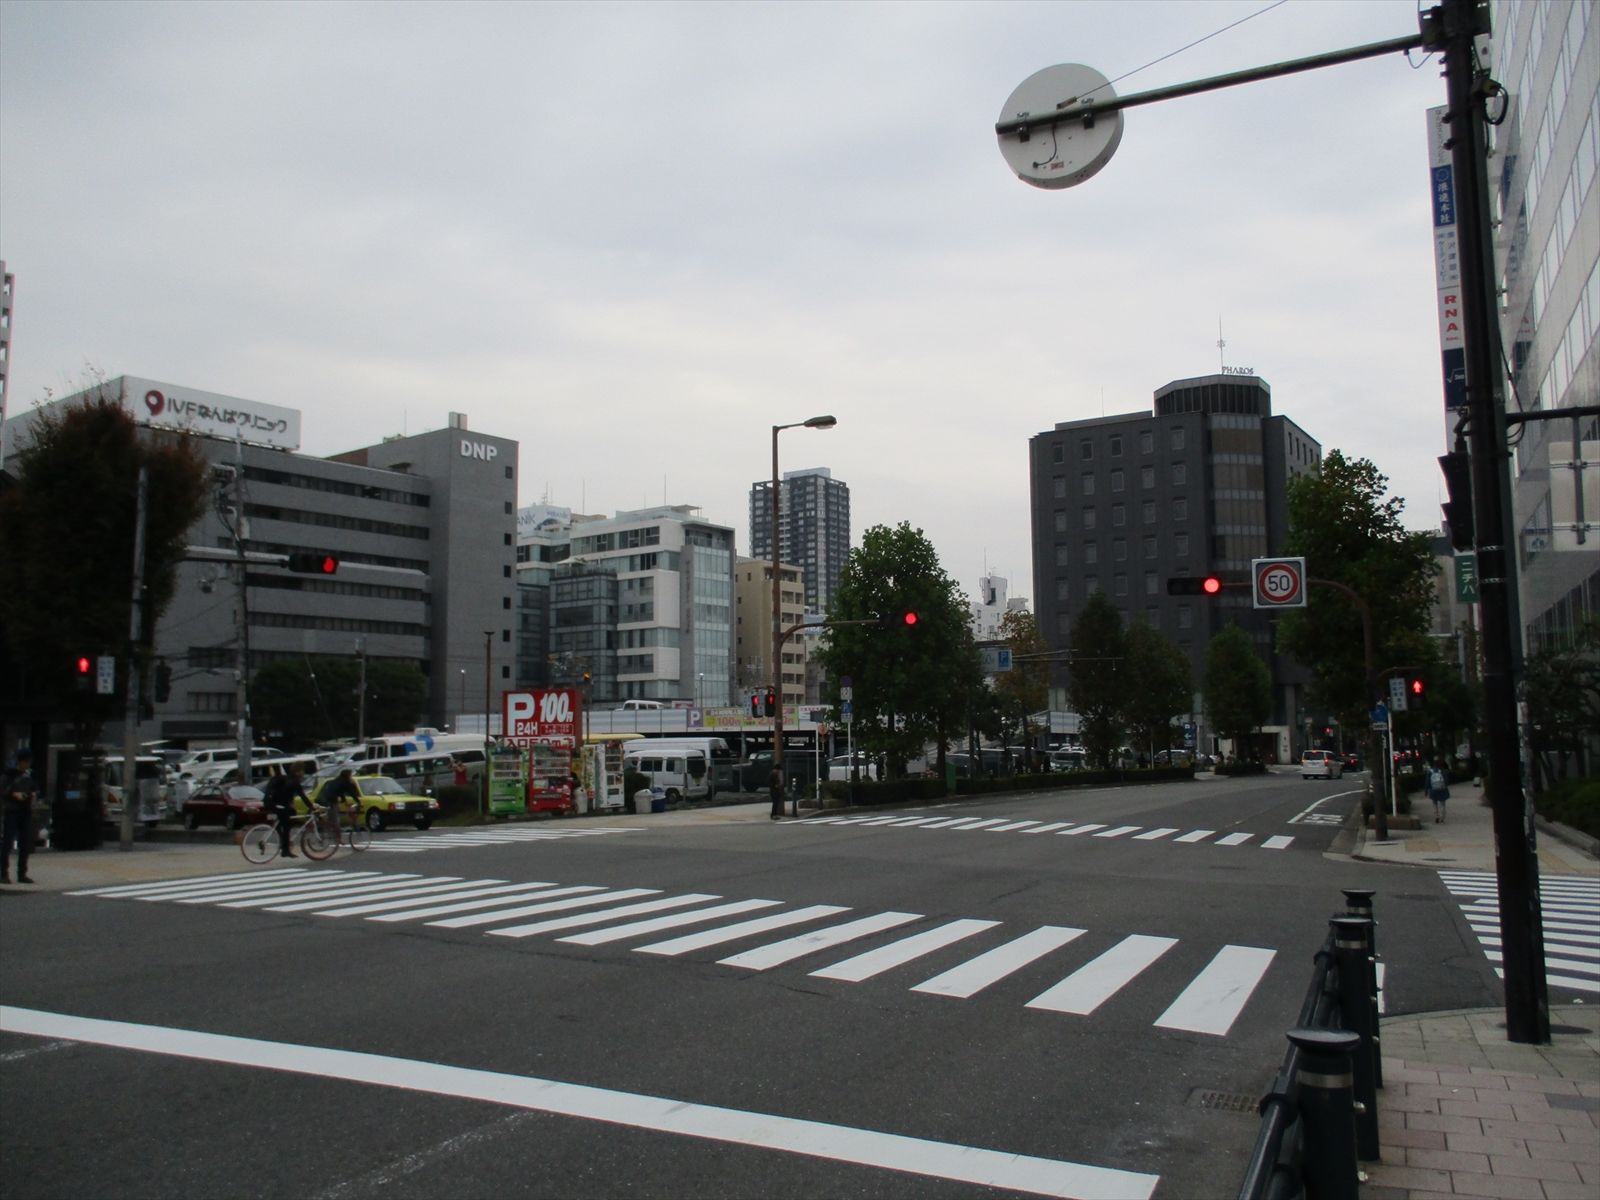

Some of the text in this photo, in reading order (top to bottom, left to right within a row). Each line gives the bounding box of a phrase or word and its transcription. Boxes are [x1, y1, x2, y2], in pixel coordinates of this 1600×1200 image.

[1444, 295, 1458, 332] RNA
[1221, 366, 1254, 376] PHAROS
[167, 397, 288, 434] IVFなんばクリニック
[460, 440, 498, 461] DNP
[1268, 574, 1290, 592] 50
[1461, 561, 1475, 595] ニチハ
[507, 693, 535, 736] P
[689, 710, 700, 726] P
[516, 721, 538, 735] 24H
